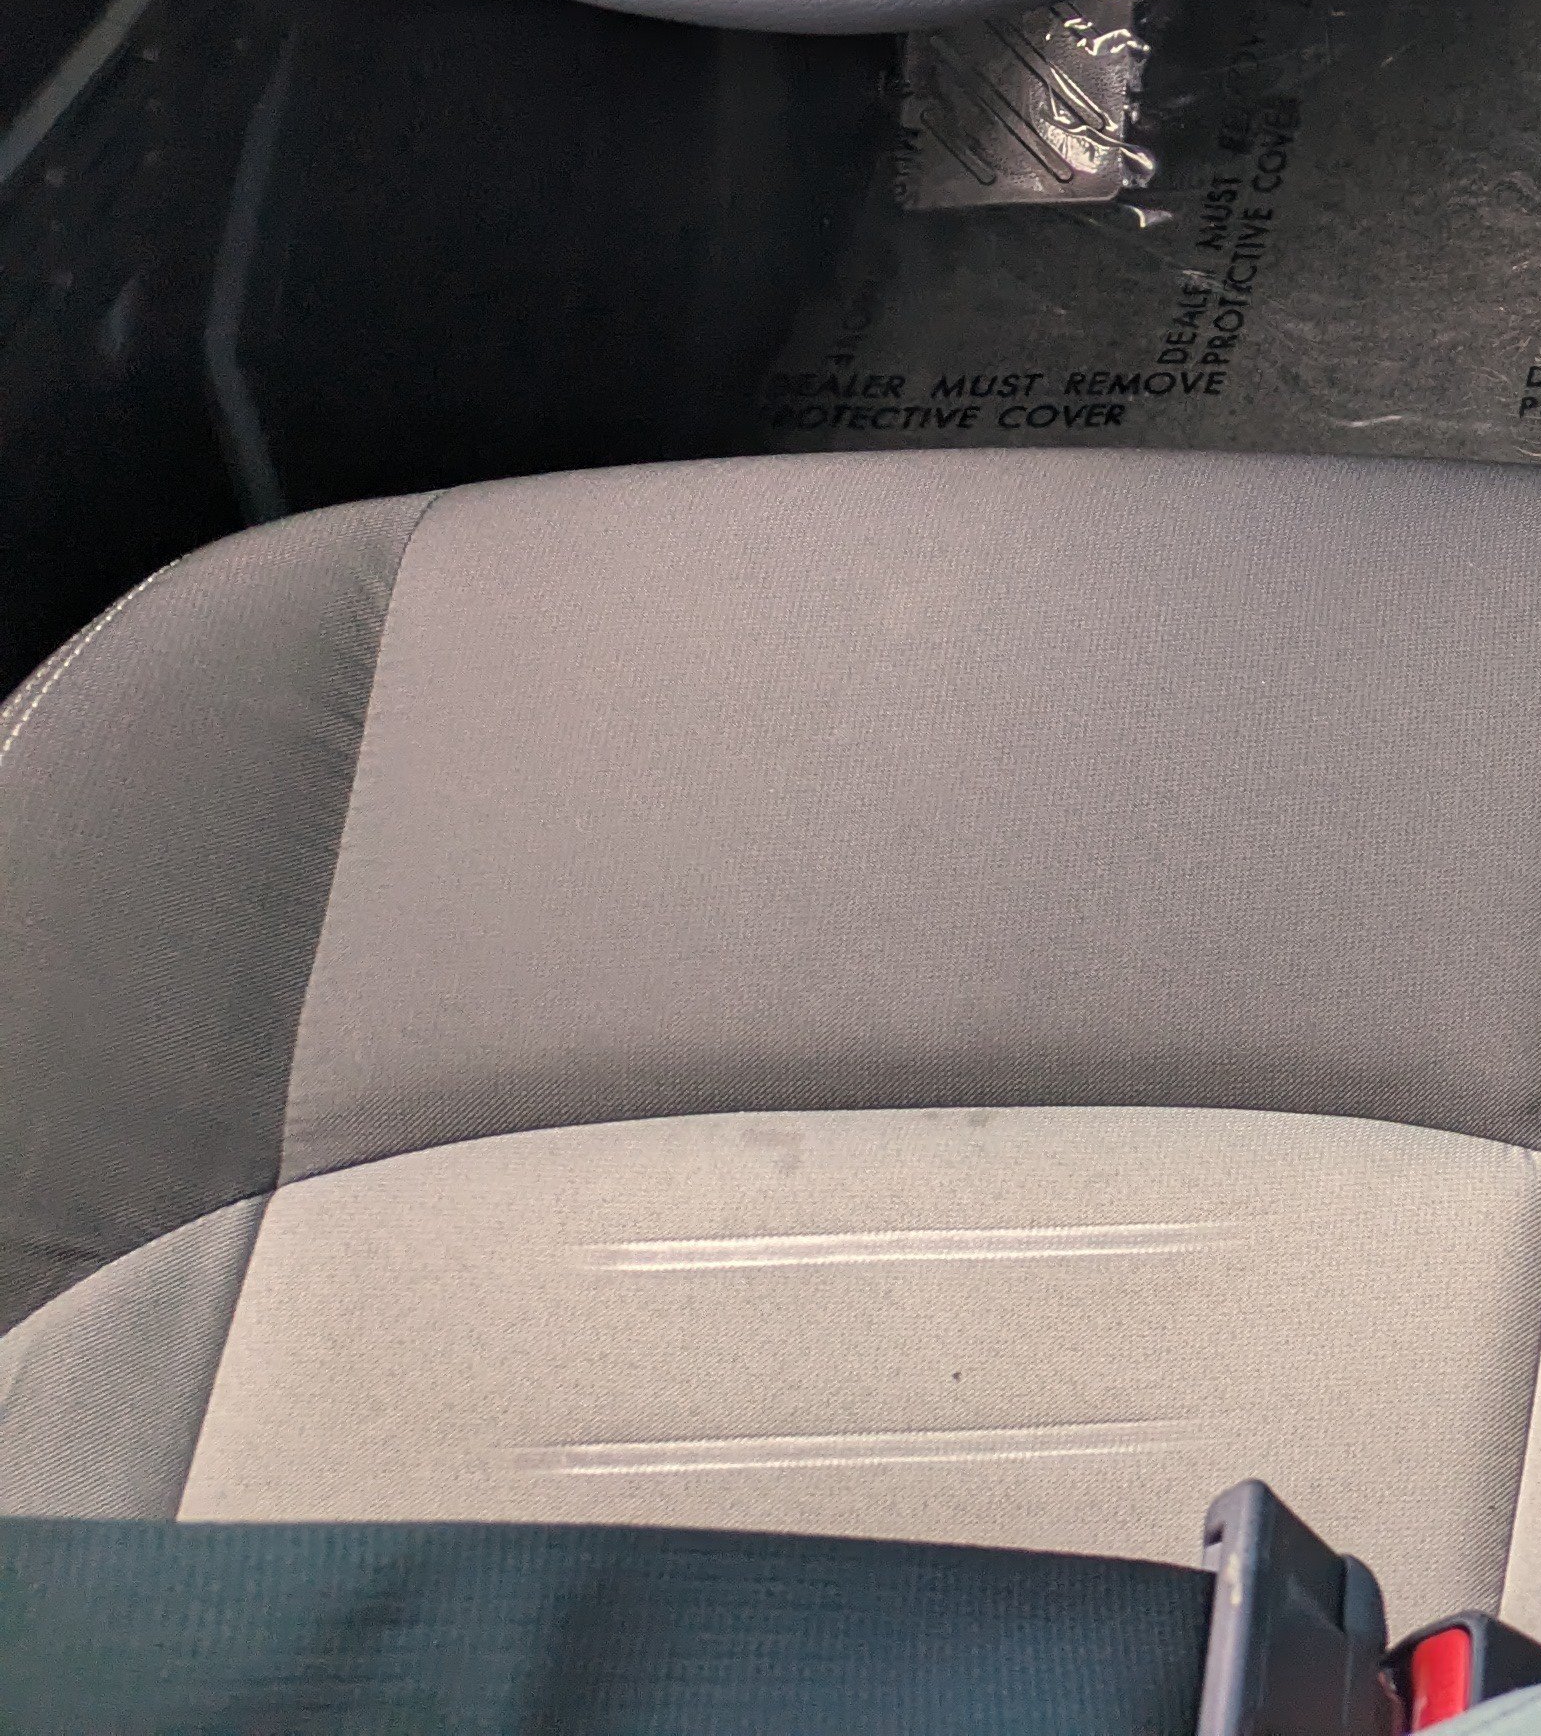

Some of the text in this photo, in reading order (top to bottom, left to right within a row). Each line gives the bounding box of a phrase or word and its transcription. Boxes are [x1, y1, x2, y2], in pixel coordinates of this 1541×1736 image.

[931, 373, 1044, 398] MUST
[1063, 371, 1228, 396] REMOVE
[998, 403, 1126, 430] COVER
